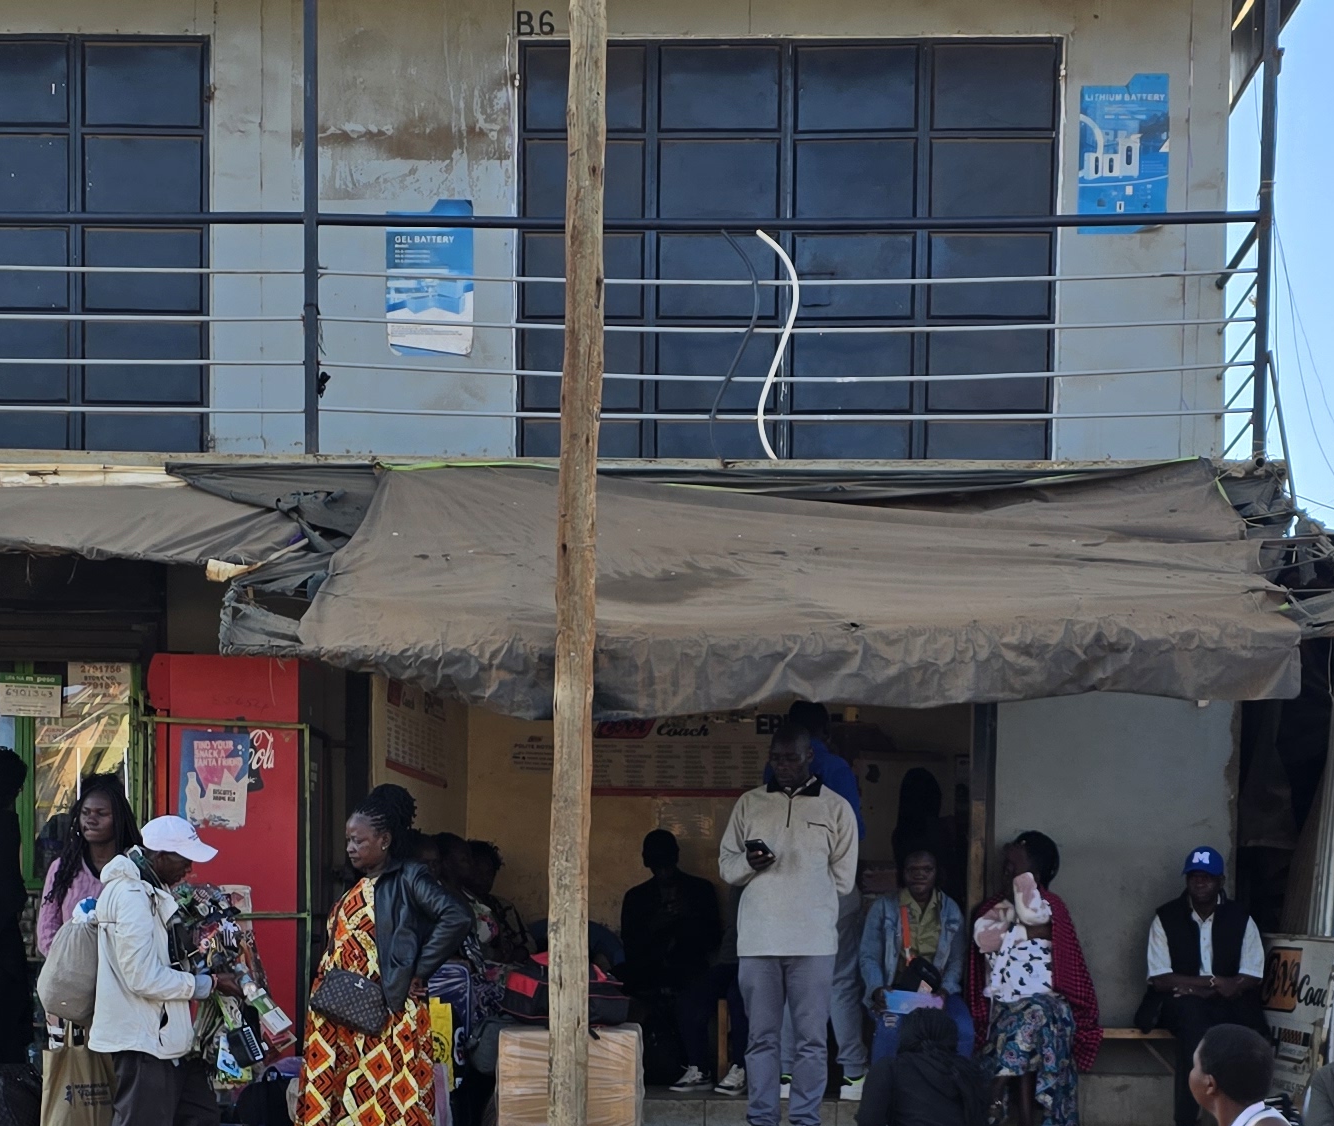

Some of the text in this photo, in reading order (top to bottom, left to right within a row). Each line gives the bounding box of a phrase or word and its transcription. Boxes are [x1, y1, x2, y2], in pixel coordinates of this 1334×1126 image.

[1085, 93, 1166, 101] LITHIUM BATTERY
[395, 235, 455, 243] GEL BATTERY
[1192, 851, 1210, 864] M
